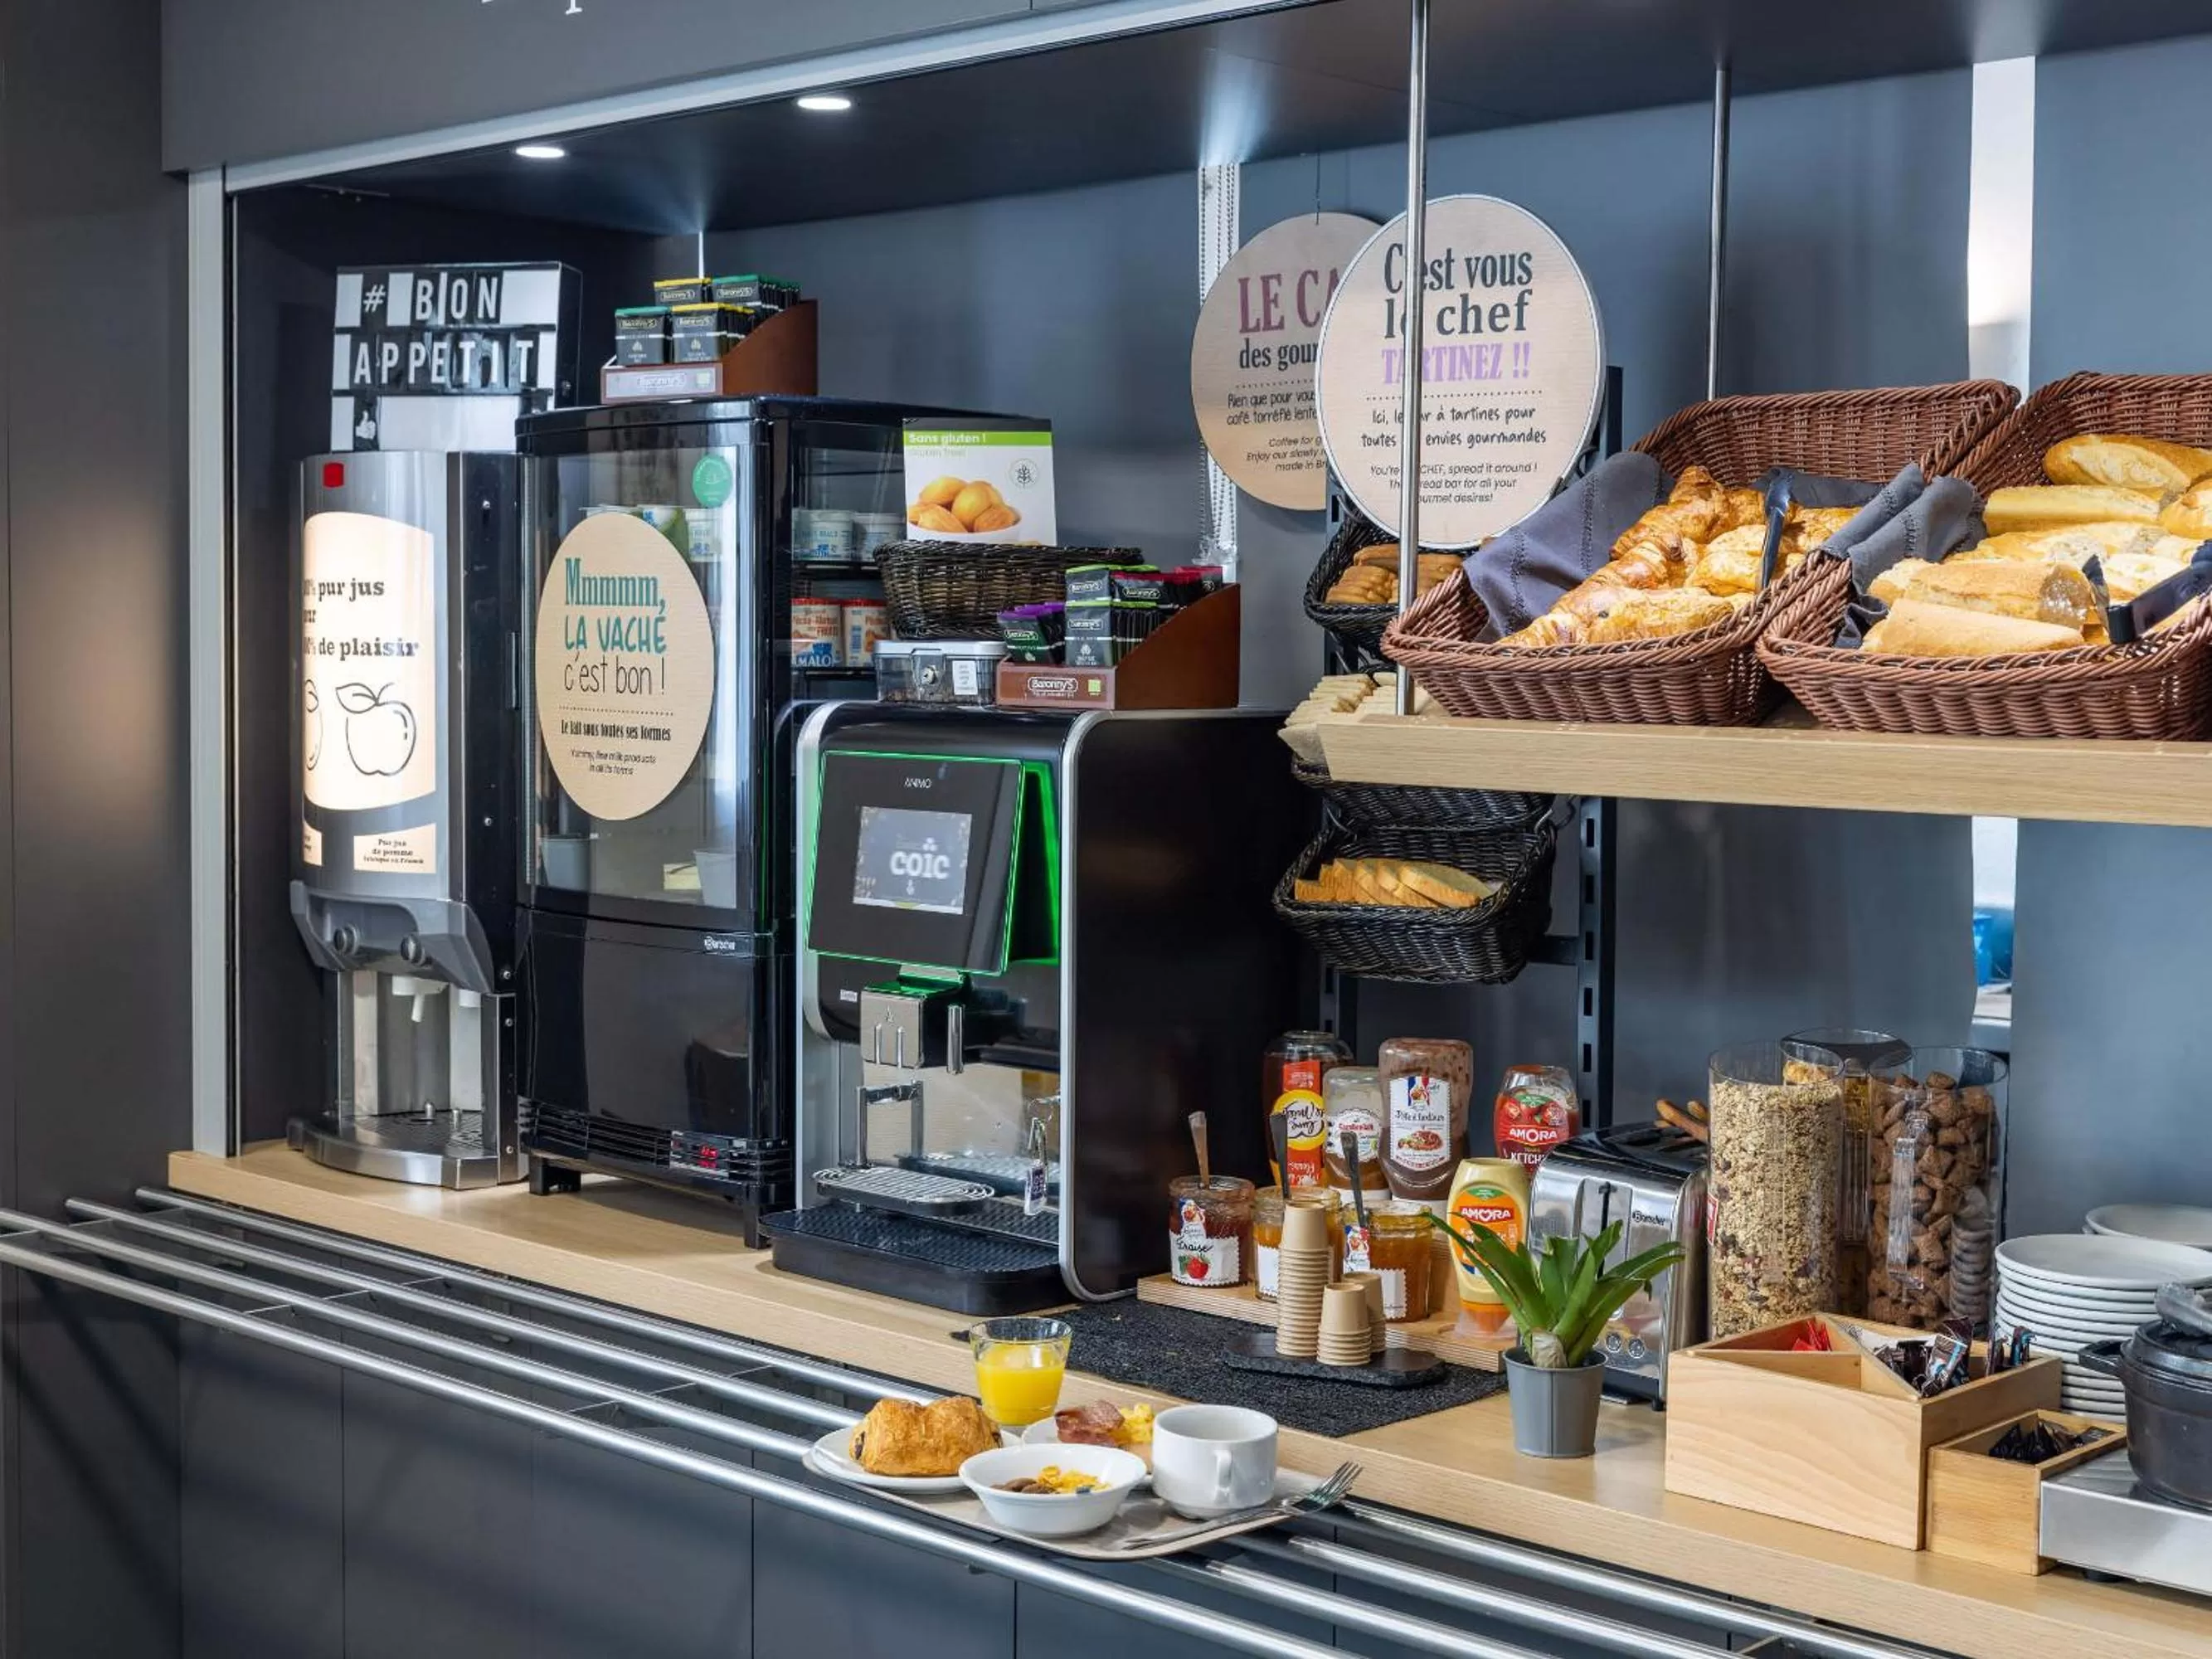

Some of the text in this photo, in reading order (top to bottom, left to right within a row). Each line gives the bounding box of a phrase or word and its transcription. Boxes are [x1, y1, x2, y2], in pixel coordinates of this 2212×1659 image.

[1384, 243, 1533, 294] Cst vous
[1238, 267, 1340, 333] LE CA
[1384, 289, 1533, 338] l chef
[354, 340, 533, 384] APPETIT
[1240, 338, 1319, 372] des gour
[1250, 394, 1267, 408] que
[1271, 392, 1292, 407] pour
[1437, 405, 1445, 421] à
[1450, 406, 1500, 422] tartines
[1505, 407, 1536, 425] pour
[909, 432, 940, 444] Sans
[942, 431, 980, 445] gluten
[1361, 427, 1547, 449] toutes envies gourmandes
[1449, 463, 1484, 475] spread
[1495, 463, 1531, 474] around
[1389, 479, 1401, 489] Th
[1494, 479, 1517, 490] your
[318, 581, 345, 601] pur
[349, 577, 384, 602] jus
[565, 615, 667, 654] LA VACHE
[318, 637, 335, 655] de
[340, 637, 419, 661] plaisir
[564, 651, 608, 693] c'est
[616, 655, 652, 695] bon
[1510, 1128, 1558, 1142] AMORA
[1510, 1151, 1545, 1165] KETCH
[1461, 1206, 1512, 1222] AMORA
